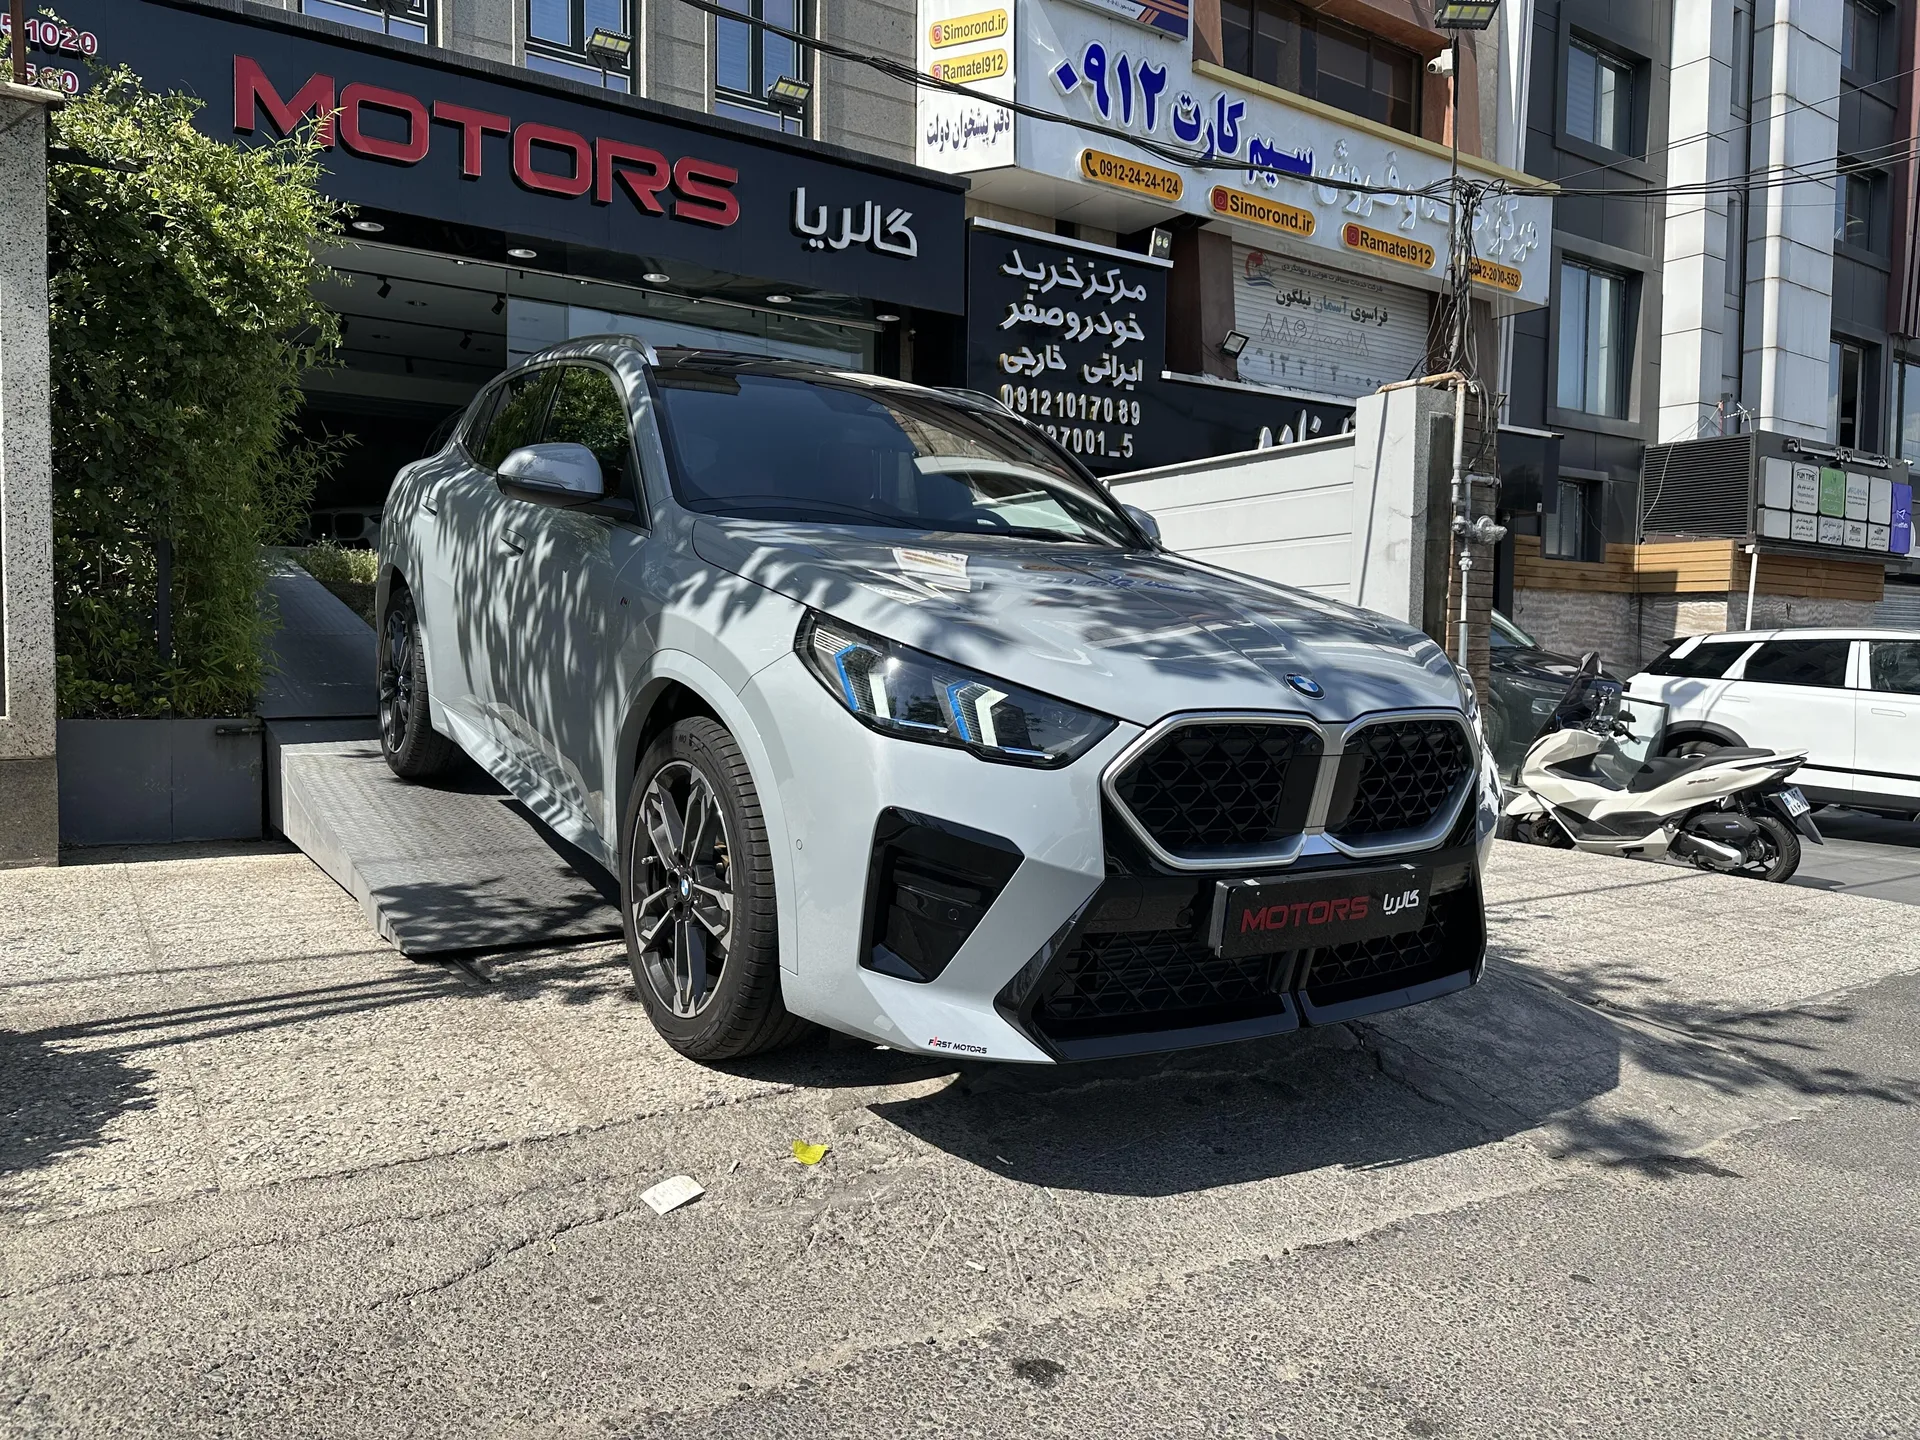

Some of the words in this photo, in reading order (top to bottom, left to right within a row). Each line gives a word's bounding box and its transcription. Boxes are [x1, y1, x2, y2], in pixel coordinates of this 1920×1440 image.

[943, 14, 1006, 41] Simorond.ir
[942, 54, 1004, 80] Ramatel912
[1053, 41, 1168, 133] ۰۹۱۲
[233, 53, 740, 227] MOTORS
[926, 112, 950, 152] دولت
[952, 107, 989, 149] پیشخوان
[991, 108, 1010, 144] دفتر
[1172, 92, 1247, 164] کارت
[1099, 161, 1179, 195] 0912-24-24-124
[1248, 136, 1315, 188] سیم
[796, 187, 918, 257] گالریا
[1229, 193, 1313, 233] Simorond.ir
[1360, 230, 1432, 265] Ramatel912
[1001, 249, 1085, 293] خرید
[1081, 261, 1147, 304] مرکز
[1275, 288, 1312, 310] نیلگون
[1313, 295, 1350, 313] آسمان
[1350, 307, 1388, 327] فراسوی
[1001, 345, 1067, 378] خارجی
[1083, 353, 1143, 391] ایرانی
[1039, 424, 1134, 458] 7001_5
[1241, 896, 1370, 933] MOTORS
[1383, 889, 1420, 916] گالریا
[928, 1036, 952, 1048] FIRST
[952, 1043, 987, 1054] MOTORS
